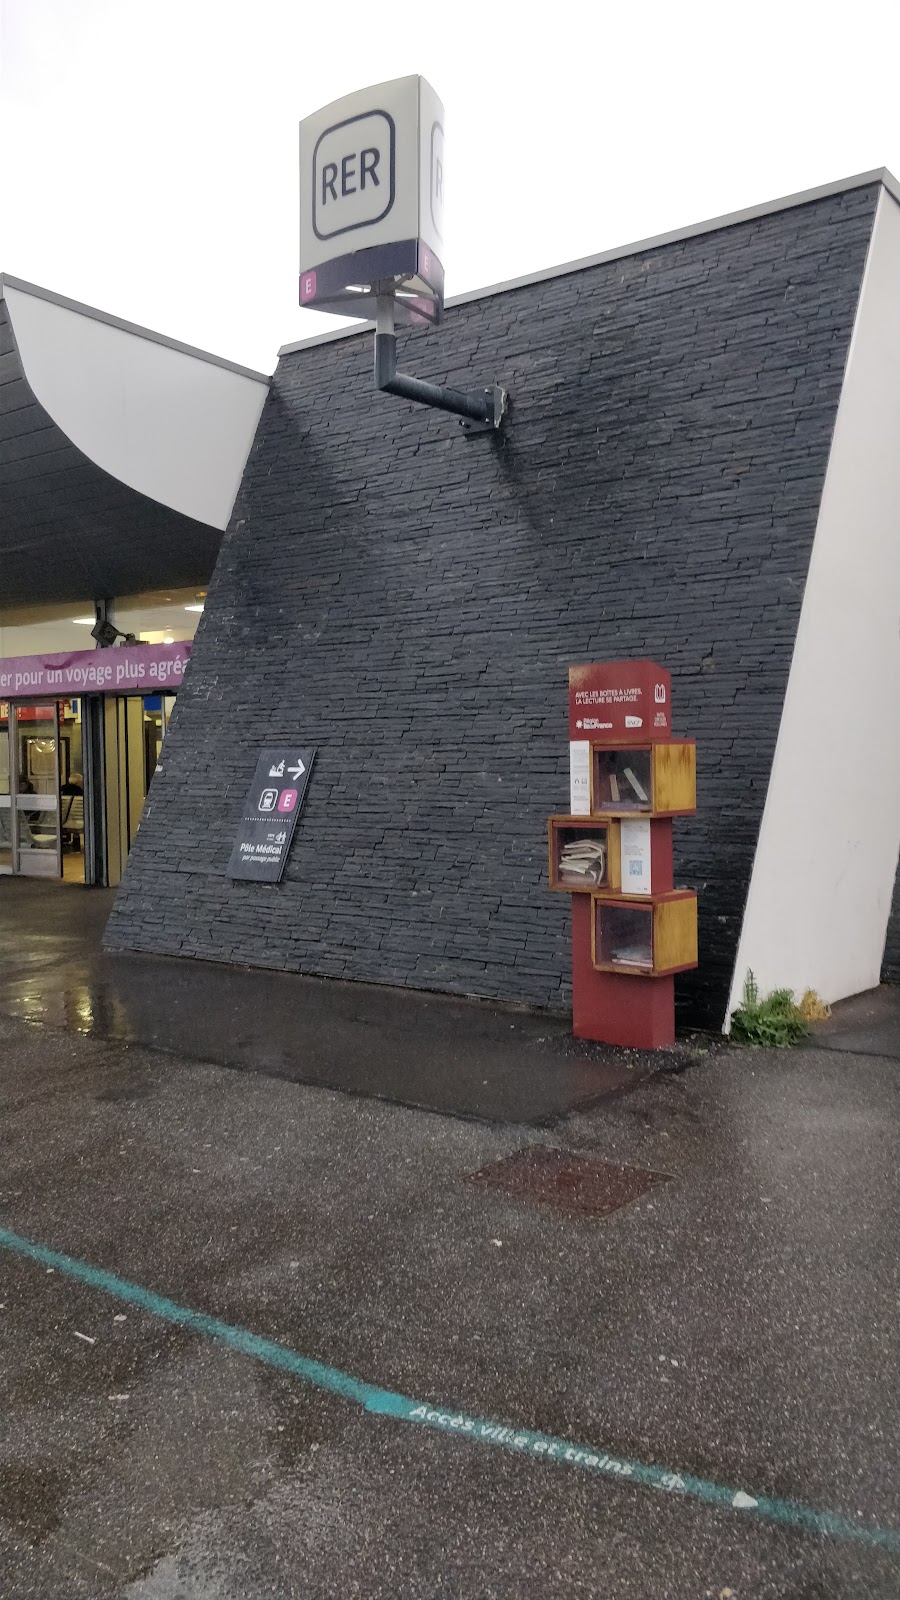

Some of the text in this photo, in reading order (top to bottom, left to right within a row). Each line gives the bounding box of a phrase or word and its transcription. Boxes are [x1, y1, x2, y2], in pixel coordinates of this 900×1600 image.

[322, 147, 381, 206] RER
[424, 256, 430, 272] E
[306, 278, 312, 294] E
[15, 671, 43, 691] pour
[47, 669, 63, 684] un
[66, 666, 112, 686] voyage
[116, 659, 145, 684] plus
[283, 794, 292, 807] E
[240, 843, 282, 854] Pôle Médical
[481, 1425, 528, 1447] ville
[565, 1448, 633, 1475] trains
